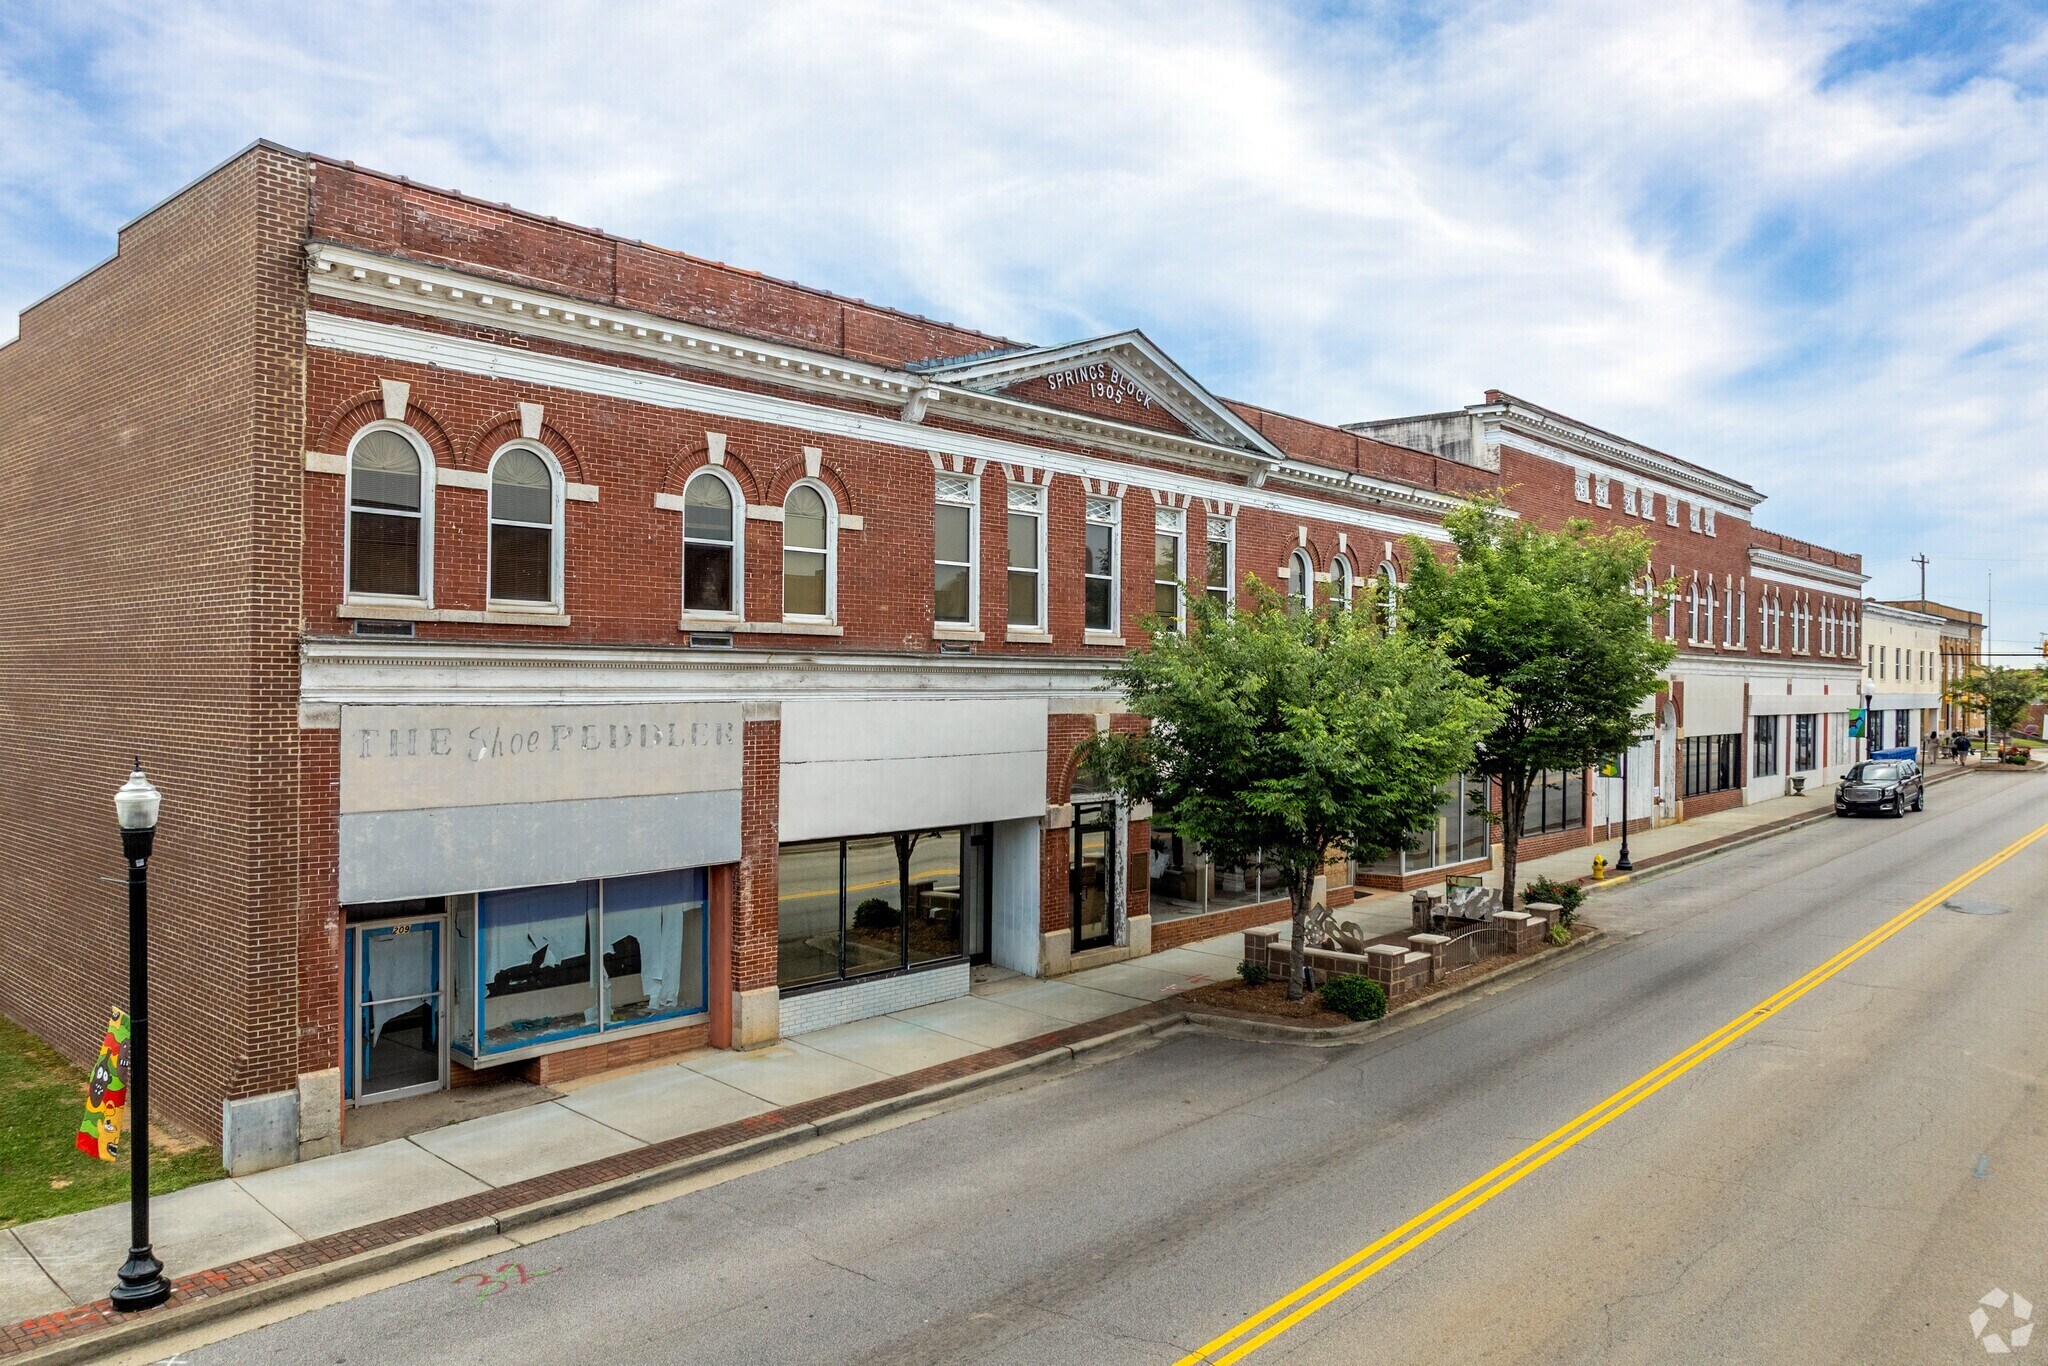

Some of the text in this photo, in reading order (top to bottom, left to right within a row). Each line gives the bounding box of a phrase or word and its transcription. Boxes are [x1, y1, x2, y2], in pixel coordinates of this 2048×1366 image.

[1047, 364, 1152, 410] SPRINGS BLOCK
[1090, 382, 1124, 404] 1905
[358, 722, 734, 762] THE Shoe PEDDLER
[392, 925, 410, 935] 209
